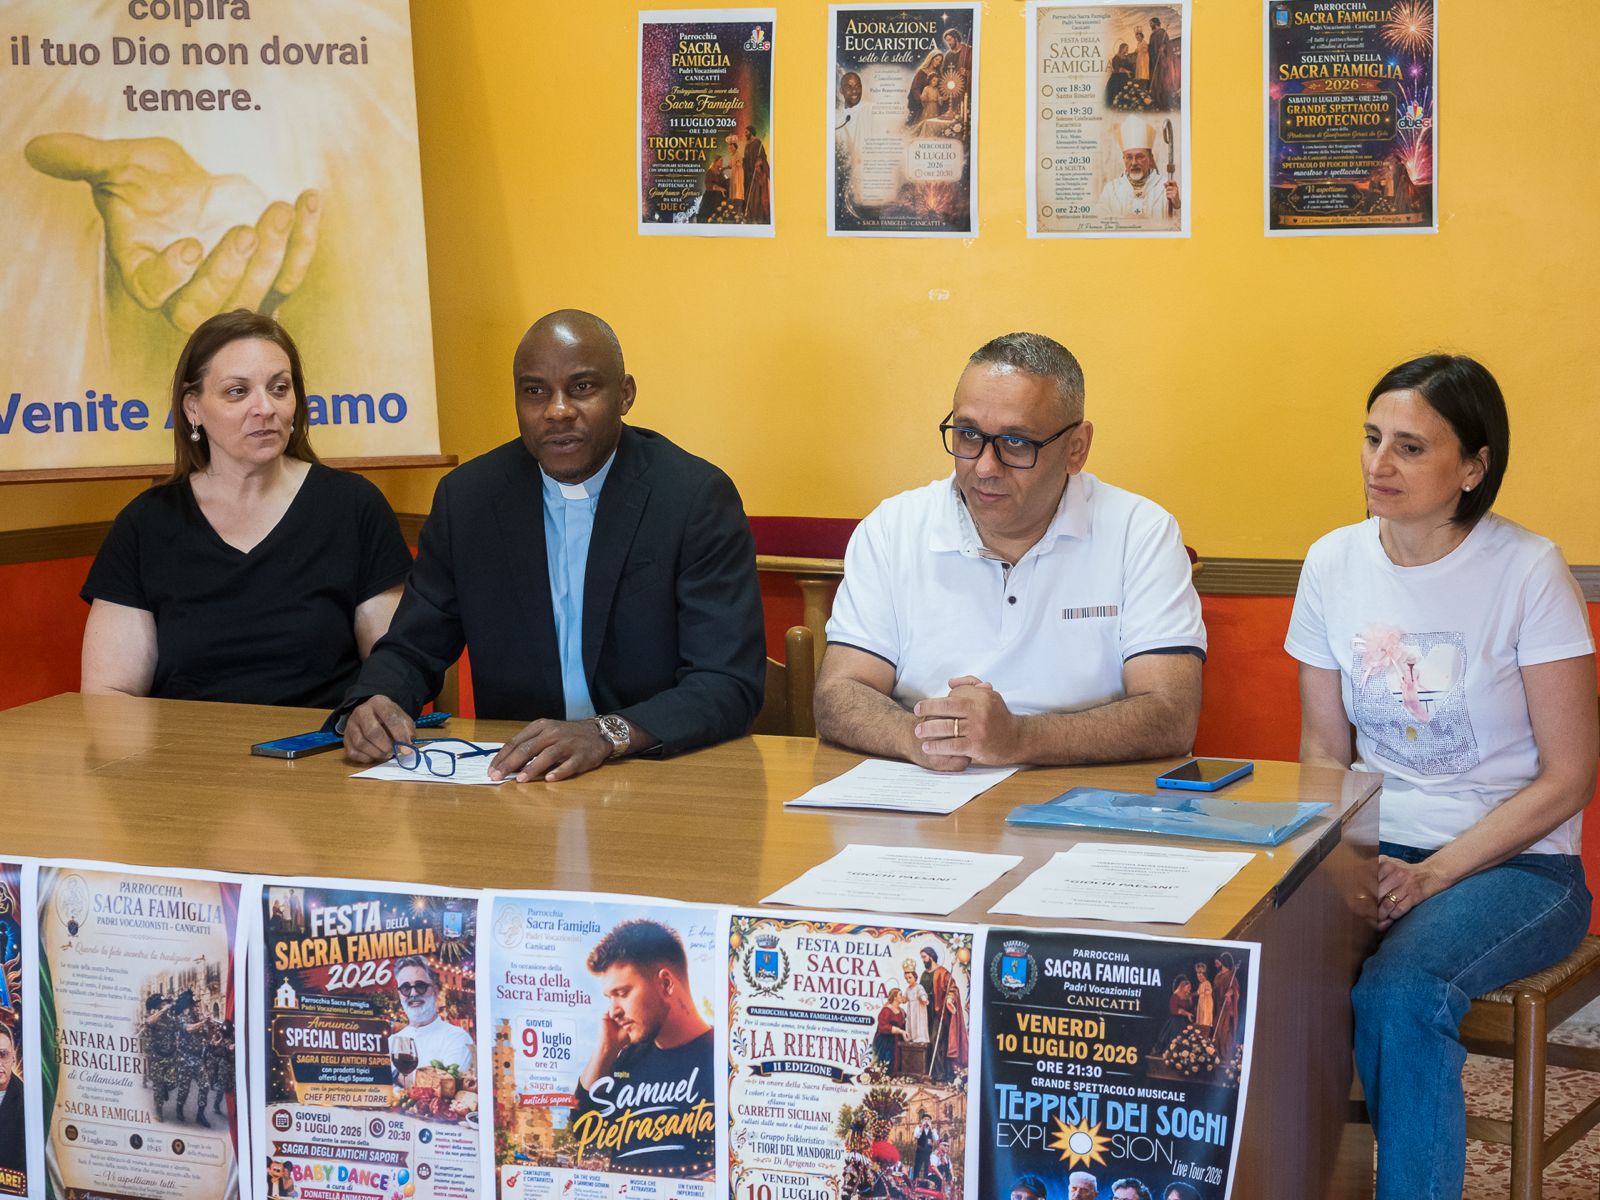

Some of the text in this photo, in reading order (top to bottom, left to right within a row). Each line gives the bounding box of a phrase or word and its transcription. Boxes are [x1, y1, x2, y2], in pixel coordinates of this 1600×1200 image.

[1295, 11, 1393, 25] SACRA FAMIGLIA
[846, 19, 936, 34] ADORAZIONE
[11, 35, 369, 65] il tuo Dio non dovrai
[679, 42, 721, 53] SACRA
[845, 36, 938, 51] EUCARISTICA
[1050, 43, 1101, 58] SACRA
[672, 54, 730, 66] FAMIGLIA
[858, 52, 913, 62] sotto le stelle
[1302, 53, 1381, 63] SOLENNITÀ DELLA
[1044, 59, 1112, 73] FAMIGLIA
[1280, 64, 1403, 81] SACRA FAMIGLIA
[1325, 80, 1359, 90] 2026
[123, 85, 261, 111] temere.
[660, 95, 744, 112] Sacra Famiglia
[1287, 103, 1389, 114] GRANDE SPETTACOLO
[681, 118, 714, 127] LUGLIO
[717, 118, 736, 126] 2026
[1296, 114, 1380, 126] PIROTECNICO
[648, 137, 717, 148] TRIONFALE
[658, 149, 706, 160] USCITA
[915, 151, 956, 160] 8 LUGLIO
[120, 882, 183, 897] PARROCCHIA
[94, 894, 222, 924] SACRA FAMIGLIA
[528, 908, 563, 917] Parrocchia
[97, 917, 168, 930] PADRI VOCAZIONISTI
[311, 901, 381, 937] FESTA
[386, 917, 409, 928] DELLA
[526, 918, 600, 935] Sacra Famiglia
[276, 928, 436, 970] SACRA FAMIGLIA
[797, 937, 892, 957] FESTA DELLA
[1073, 948, 1130, 962] PARROCCHIA
[807, 954, 881, 977] SACRA
[1045, 958, 1161, 986] SACRA FAMIGLIA
[326, 960, 391, 991] 2026
[505, 971, 570, 988] festa della
[794, 974, 889, 998] FAMIGLIA
[1064, 982, 1142, 997] Padri Vocazionisti
[497, 986, 591, 1007] Sacra Famiglia
[820, 996, 860, 1012] 2026
[1067, 995, 1140, 1011] CANICATTÌ
[750, 1008, 788, 1017] PARROCCHIA
[308, 1017, 359, 1030] Annuncio
[526, 1019, 552, 1027] GIOVEDÌ
[1017, 1012, 1105, 1039] VENERDÌ
[286, 1028, 381, 1052] SPECIAL GUEST
[523, 1028, 572, 1057] 9 luglio
[543, 1047, 570, 1060] 2026
[750, 1029, 862, 1068] LA RIETINA
[996, 1033, 1137, 1064] 10 LUGLIO 2026
[297, 1056, 319, 1064] SAGRA
[321, 1056, 339, 1064] DEGLI
[341, 1056, 367, 1065] ANTICHI
[550, 1061, 558, 1069] 21
[773, 1062, 832, 1076] II EDIZIONE
[1037, 1060, 1102, 1078] ORE 21:30
[68, 1070, 135, 1087] di Caltanissetta
[530, 1082, 554, 1091] sagra
[589, 1067, 699, 1117] Samuel
[1032, 1077, 1185, 1102] GRANDE SPETTACOLO MUSICALE
[304, 1093, 323, 1101] CHEF
[64, 1100, 151, 1123] SACRA FAMIGLIA
[296, 1112, 331, 1121] GIOVEDÌ
[738, 1104, 785, 1118] CARRETTI
[995, 1083, 1227, 1146] TEPPISTI DEI SOGNI
[296, 1124, 362, 1136] 9 LUGLIO 2026
[388, 1121, 404, 1129] ORE
[573, 1098, 715, 1165] Pietrasanta
[388, 1130, 411, 1141] 20:30
[761, 1132, 784, 1142] Gruppo
[282, 1144, 399, 1163] SAGRA DEGLI ANTICHI SAPORI
[758, 1143, 779, 1155] FIORI
[781, 1145, 795, 1157] DEL
[293, 1164, 389, 1190] BABY DANCE
[763, 1173, 809, 1186] VENERDÌ
[1172, 1160, 1221, 1185] Live Tour 2026
[747, 1184, 771, 1200] 10
